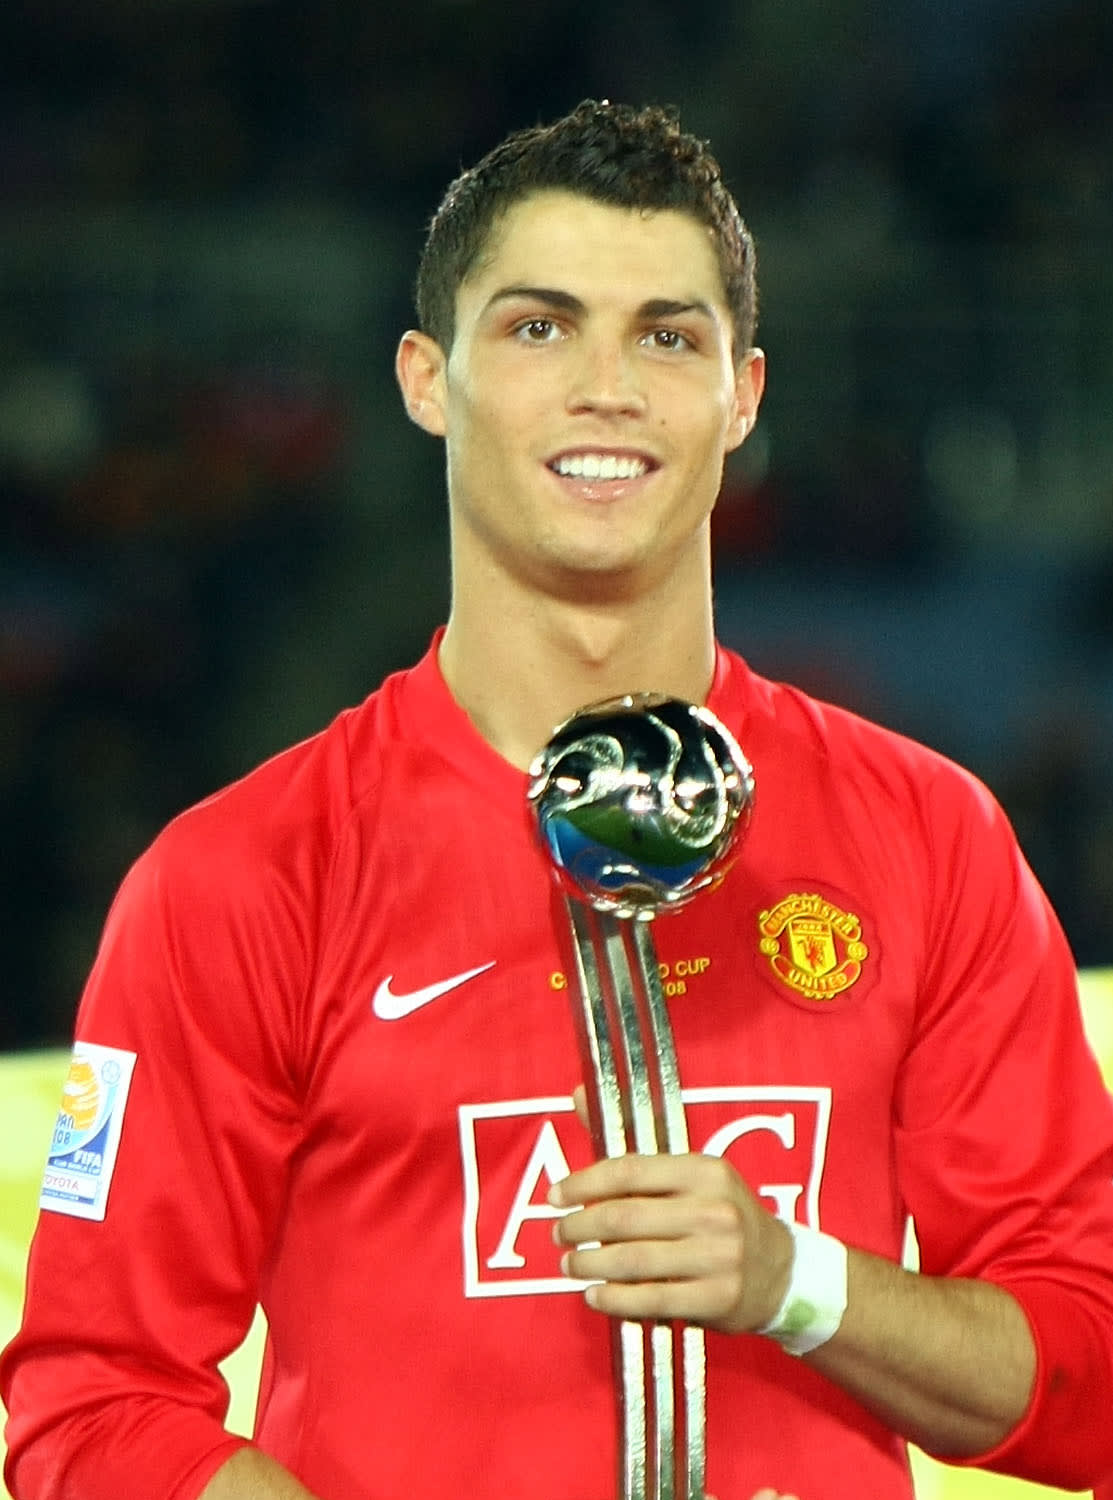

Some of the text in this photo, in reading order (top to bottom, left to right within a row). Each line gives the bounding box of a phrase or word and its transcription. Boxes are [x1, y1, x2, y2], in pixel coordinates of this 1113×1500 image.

[766, 900, 855, 935] MANCHESTER
[675, 957, 711, 977] CUP
[788, 968, 848, 991] UNITED
[44, 1173, 80, 1191] OYOTA
[487, 1112, 803, 1269] AG
